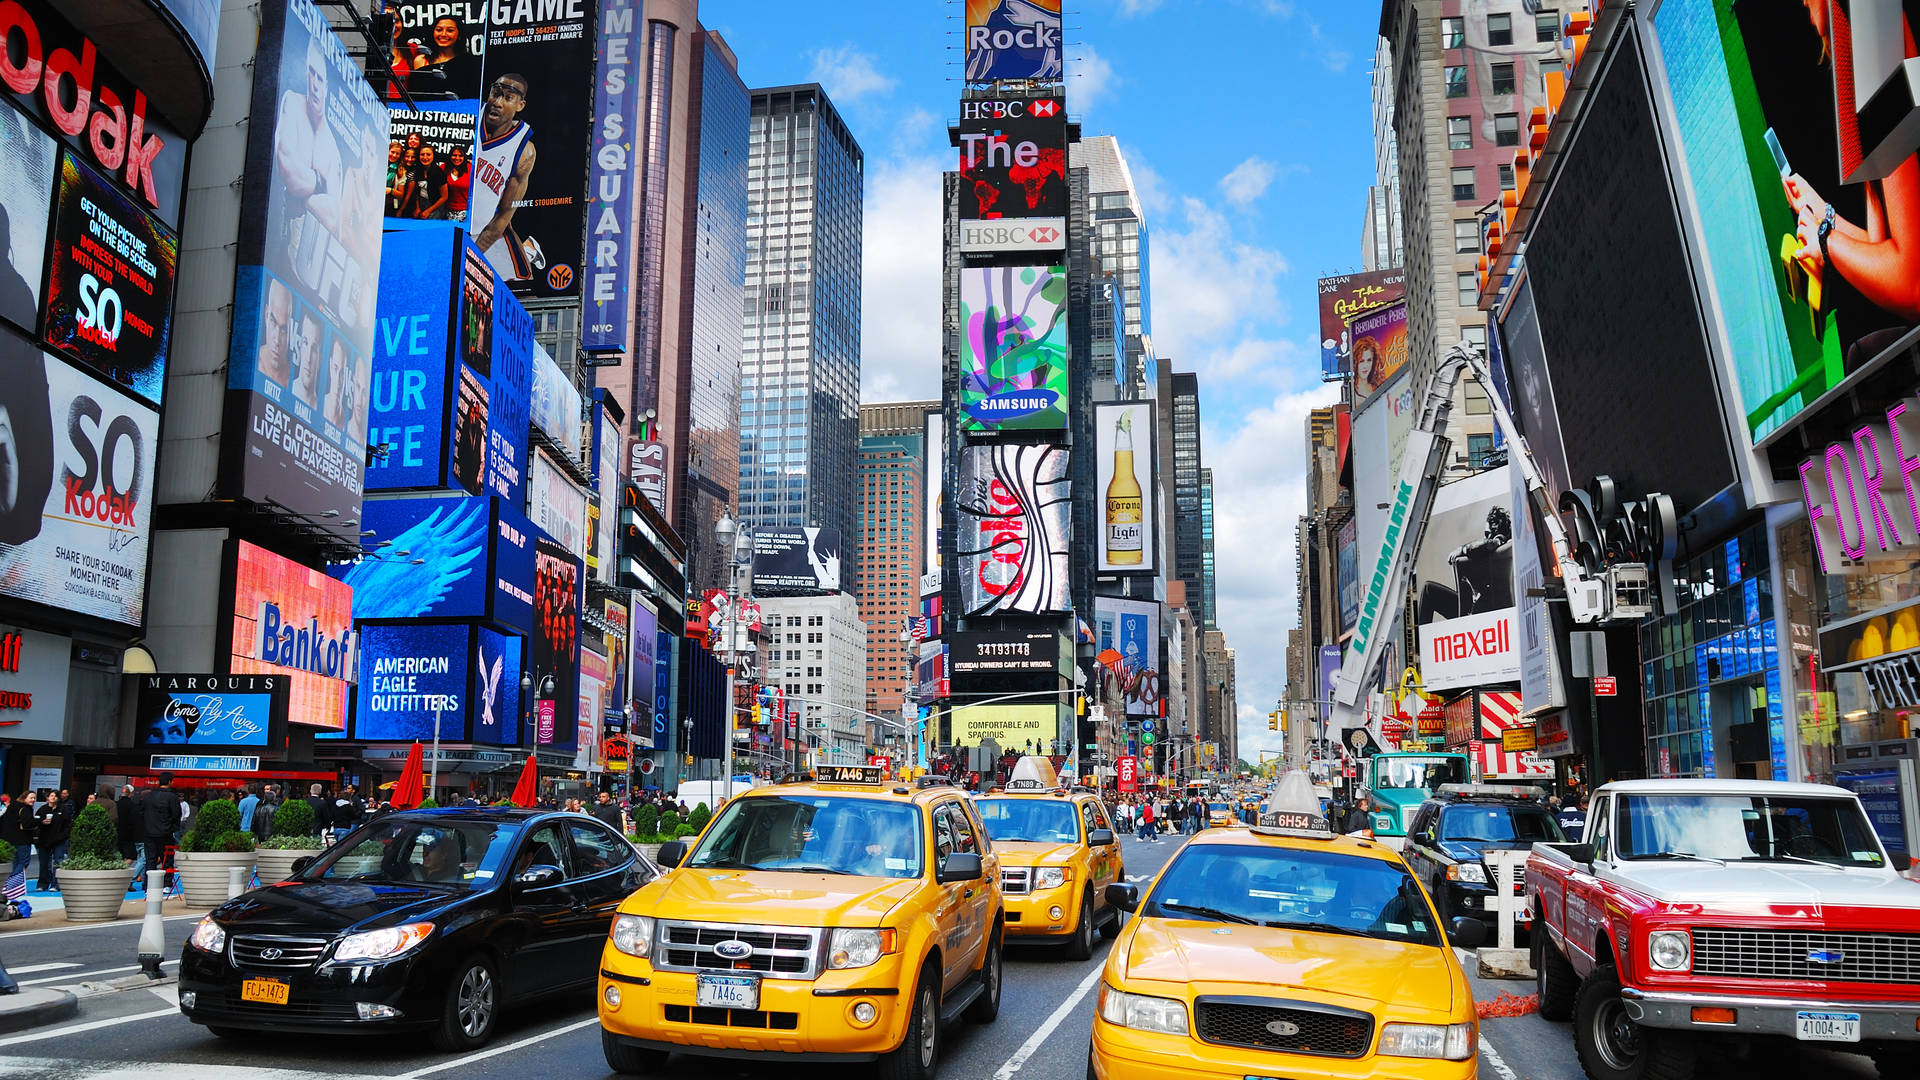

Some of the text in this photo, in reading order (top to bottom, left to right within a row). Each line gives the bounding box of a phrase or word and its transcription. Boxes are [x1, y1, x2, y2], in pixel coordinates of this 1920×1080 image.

[490, 0, 585, 26] GAME
[489, 38, 502, 46] FOR
[508, 36, 533, 44] CHANCE
[533, 34, 541, 42] TO
[542, 33, 559, 41] MEET
[559, 31, 583, 40] AMAR'E
[490, 30, 505, 39] TEXT
[505, 29, 527, 37] HOOPS
[526, 27, 535, 35] TO
[557, 23, 584, 33] (KNICKS)
[969, 21, 1056, 51] Rock
[962, 100, 1024, 121] HSBC
[959, 132, 1040, 169] The
[511, 196, 574, 208] AMAR'E STOUDEMIRE
[592, 113, 628, 302] SQUARE
[80, 196, 148, 257] GET YOUR PICTURE
[964, 226, 1026, 246] HSBC
[89, 219, 158, 280] ON THE BIG SCREEN
[71, 245, 114, 286] WITH YOUR
[79, 233, 154, 296] IMPRESS THE WORLD
[1319, 276, 1350, 287] NATHAN
[1319, 285, 1338, 294] LANE
[1352, 285, 1385, 298] The
[75, 273, 154, 343] SO MOMENT
[499, 288, 527, 353] LEAVE
[591, 323, 614, 334] NYC
[1355, 313, 1387, 335] BERNADETTE
[77, 316, 118, 353] Kodak
[500, 337, 526, 397] YOUR
[979, 397, 1049, 411] SAMSUNG
[264, 403, 292, 435] SAT.
[294, 423, 344, 470] OCTOBER
[345, 457, 358, 479] 23
[491, 428, 515, 463] GET YOUR
[62, 394, 146, 515] SO
[253, 415, 281, 446] LIVE
[282, 432, 301, 458] ON
[301, 446, 364, 497] PAY-PER-VIEW
[490, 448, 520, 487] 15 SECONDS
[488, 469, 496, 488] OF
[64, 476, 137, 528] Kodak
[978, 476, 1026, 598] Coke
[1111, 525, 1139, 540] Light
[55, 546, 134, 581] SHARE YOUR SO KODAK
[1352, 479, 1414, 655] LANDMARK
[70, 566, 120, 591] MOMENT HERE
[260, 602, 325, 675] Bank
[326, 628, 351, 680] of
[1433, 617, 1511, 664] maxell
[373, 656, 449, 675] AMERICAN
[980, 661, 1004, 669] OWNERS
[1003, 661, 1021, 669] CAN'T
[1029, 660, 1053, 668] WRONG.
[147, 676, 275, 690] MARQUIS
[372, 675, 417, 693] EAGLE
[371, 694, 459, 712] OUTFITTERS
[163, 694, 263, 741] Come Fly Away
[967, 719, 1040, 730] COMFORTABLE AND
[967, 729, 1007, 740] SPACIOUS.
[173, 757, 198, 769] THARP
[219, 757, 251, 770] SINATRA
[445, 751, 474, 760] EAGLE
[819, 774, 832, 782] DUTY
[834, 767, 863, 782] 7A46
[1122, 758, 1134, 782] tkts
[1016, 779, 1034, 789] 7N89
[1278, 814, 1309, 829] 6H54
[722, 945, 743, 954] Ford
[246, 981, 285, 999] FCJ-1473
